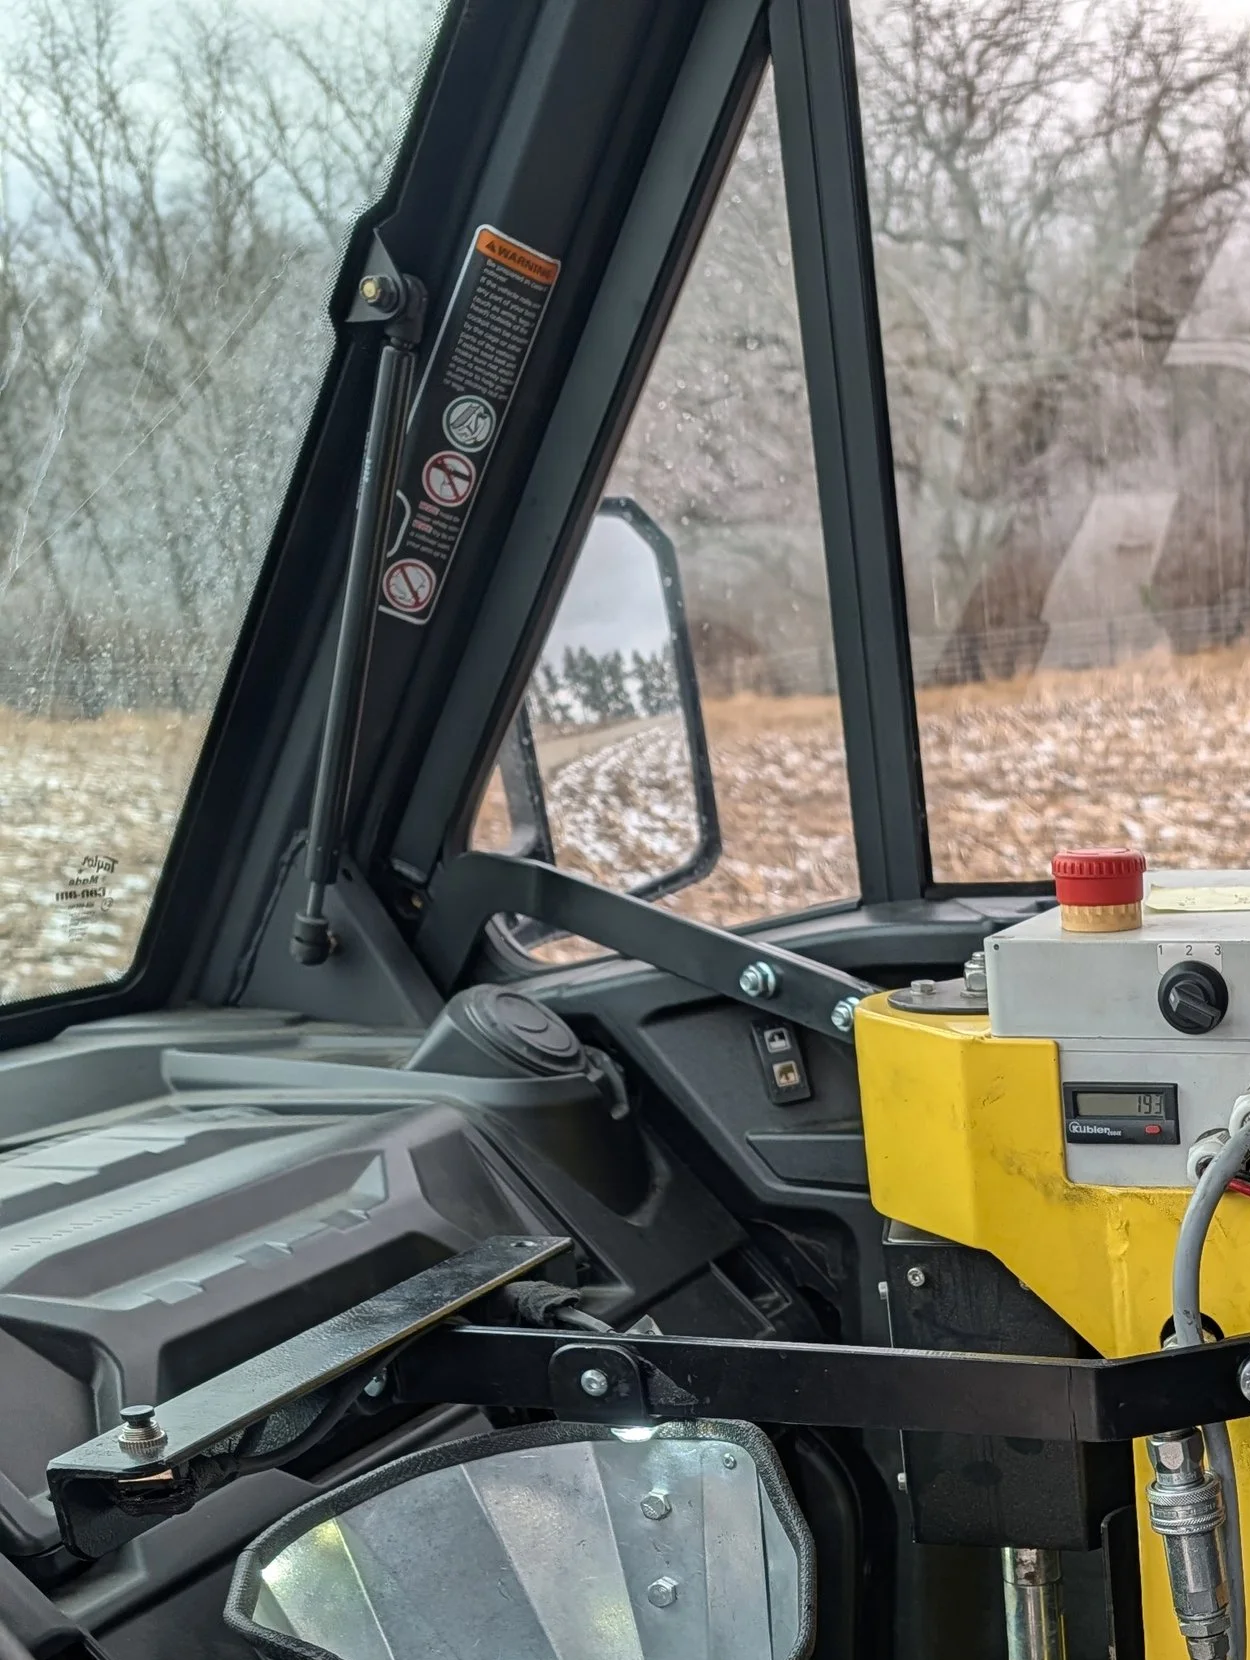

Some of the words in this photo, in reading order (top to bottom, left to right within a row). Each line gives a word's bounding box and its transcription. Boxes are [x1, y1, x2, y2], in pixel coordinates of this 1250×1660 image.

[1159, 945, 1164, 956] 1
[1185, 945, 1193, 956] 2
[1214, 945, 1221, 956] 3
